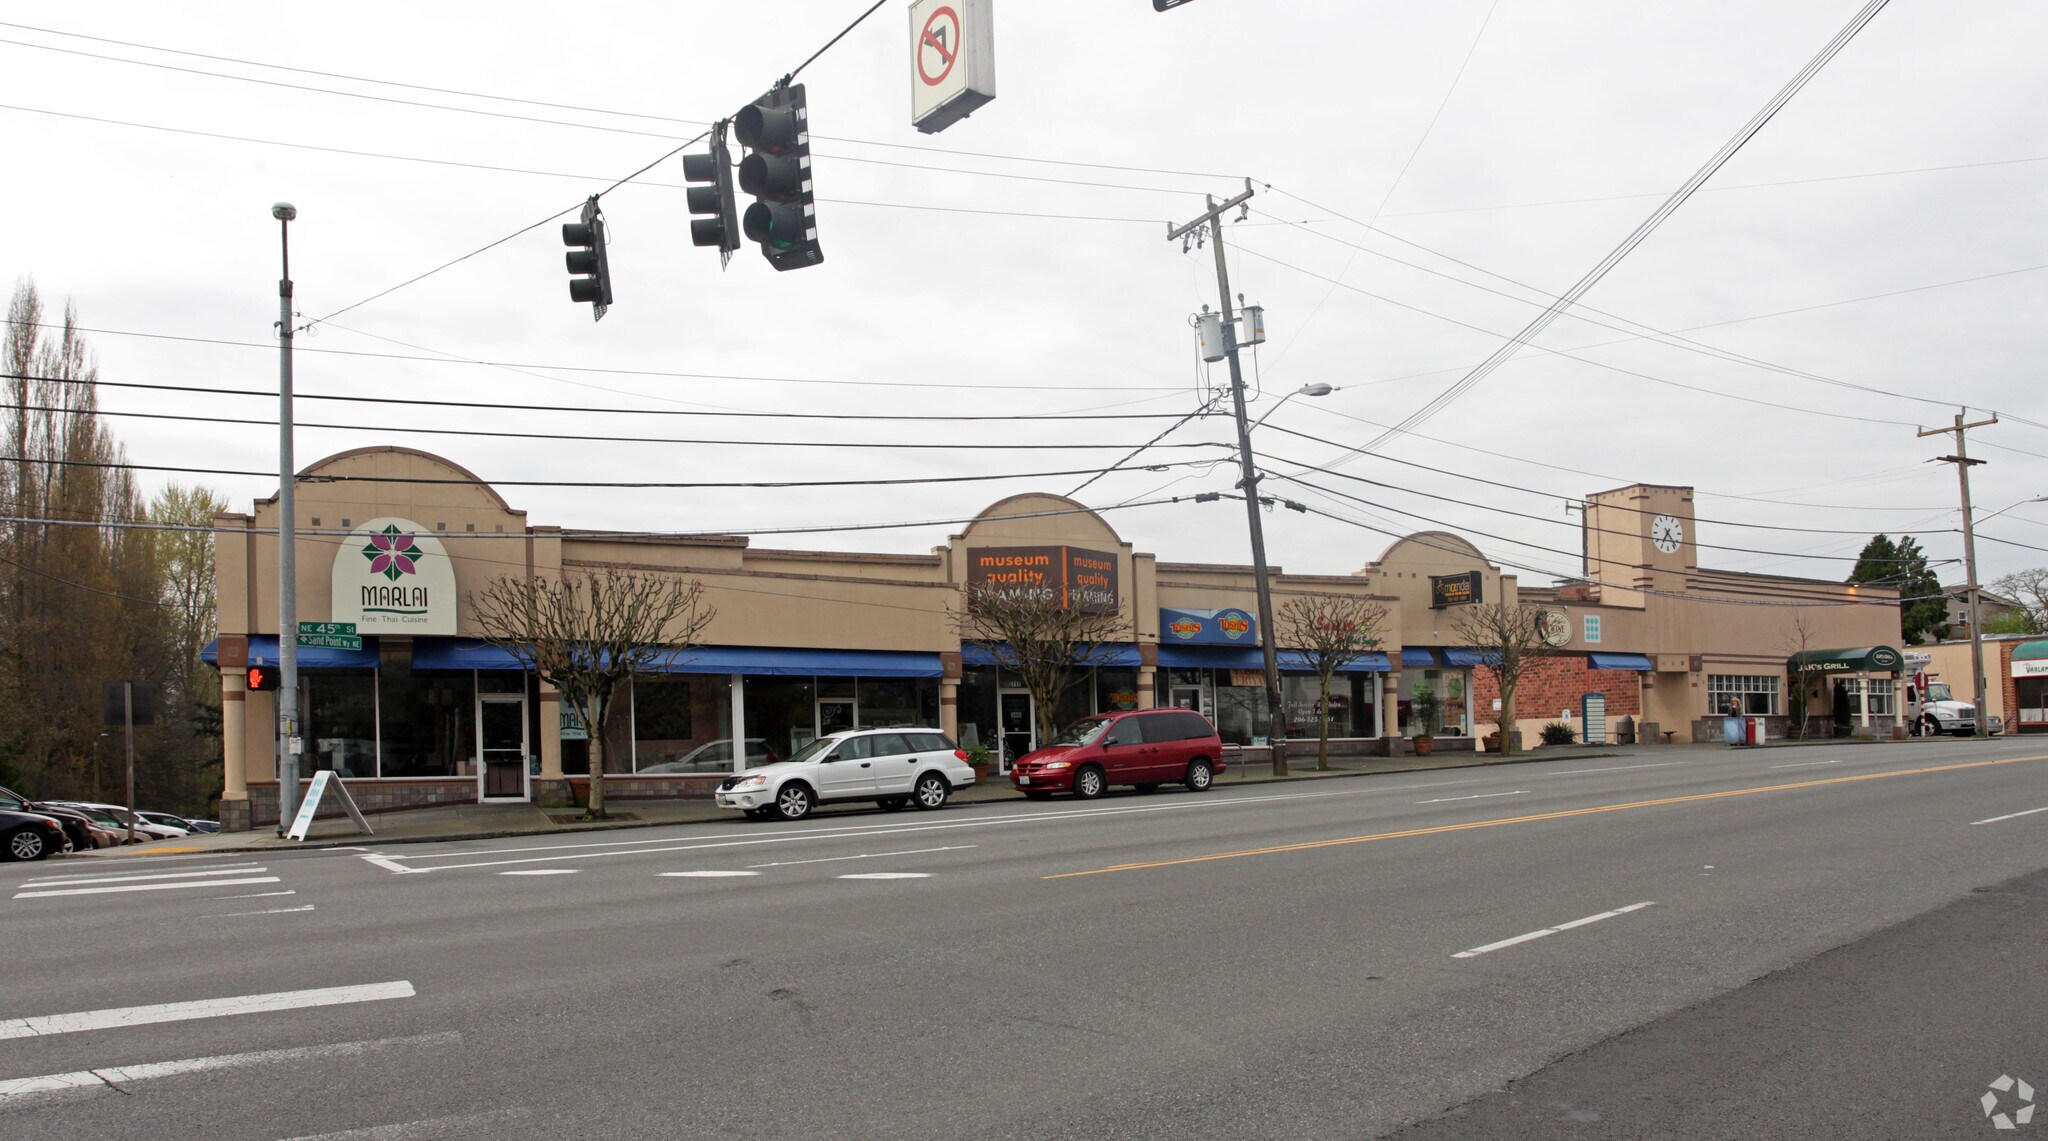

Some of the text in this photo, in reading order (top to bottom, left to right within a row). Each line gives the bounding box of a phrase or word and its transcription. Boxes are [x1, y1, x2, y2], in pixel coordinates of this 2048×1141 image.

[980, 555, 1049, 566] museum
[1074, 556, 1112, 571] museum
[986, 568, 1044, 586] quality
[1077, 573, 1109, 589] quality
[361, 585, 428, 607] MARLAI
[361, 615, 428, 624] Fine Thai Cuisine
[301, 624, 312, 632] NE
[316, 623, 341, 634] 45th
[308, 636, 360, 649] Sand Point Wy NE
[1823, 662, 1850, 670] GRILL
